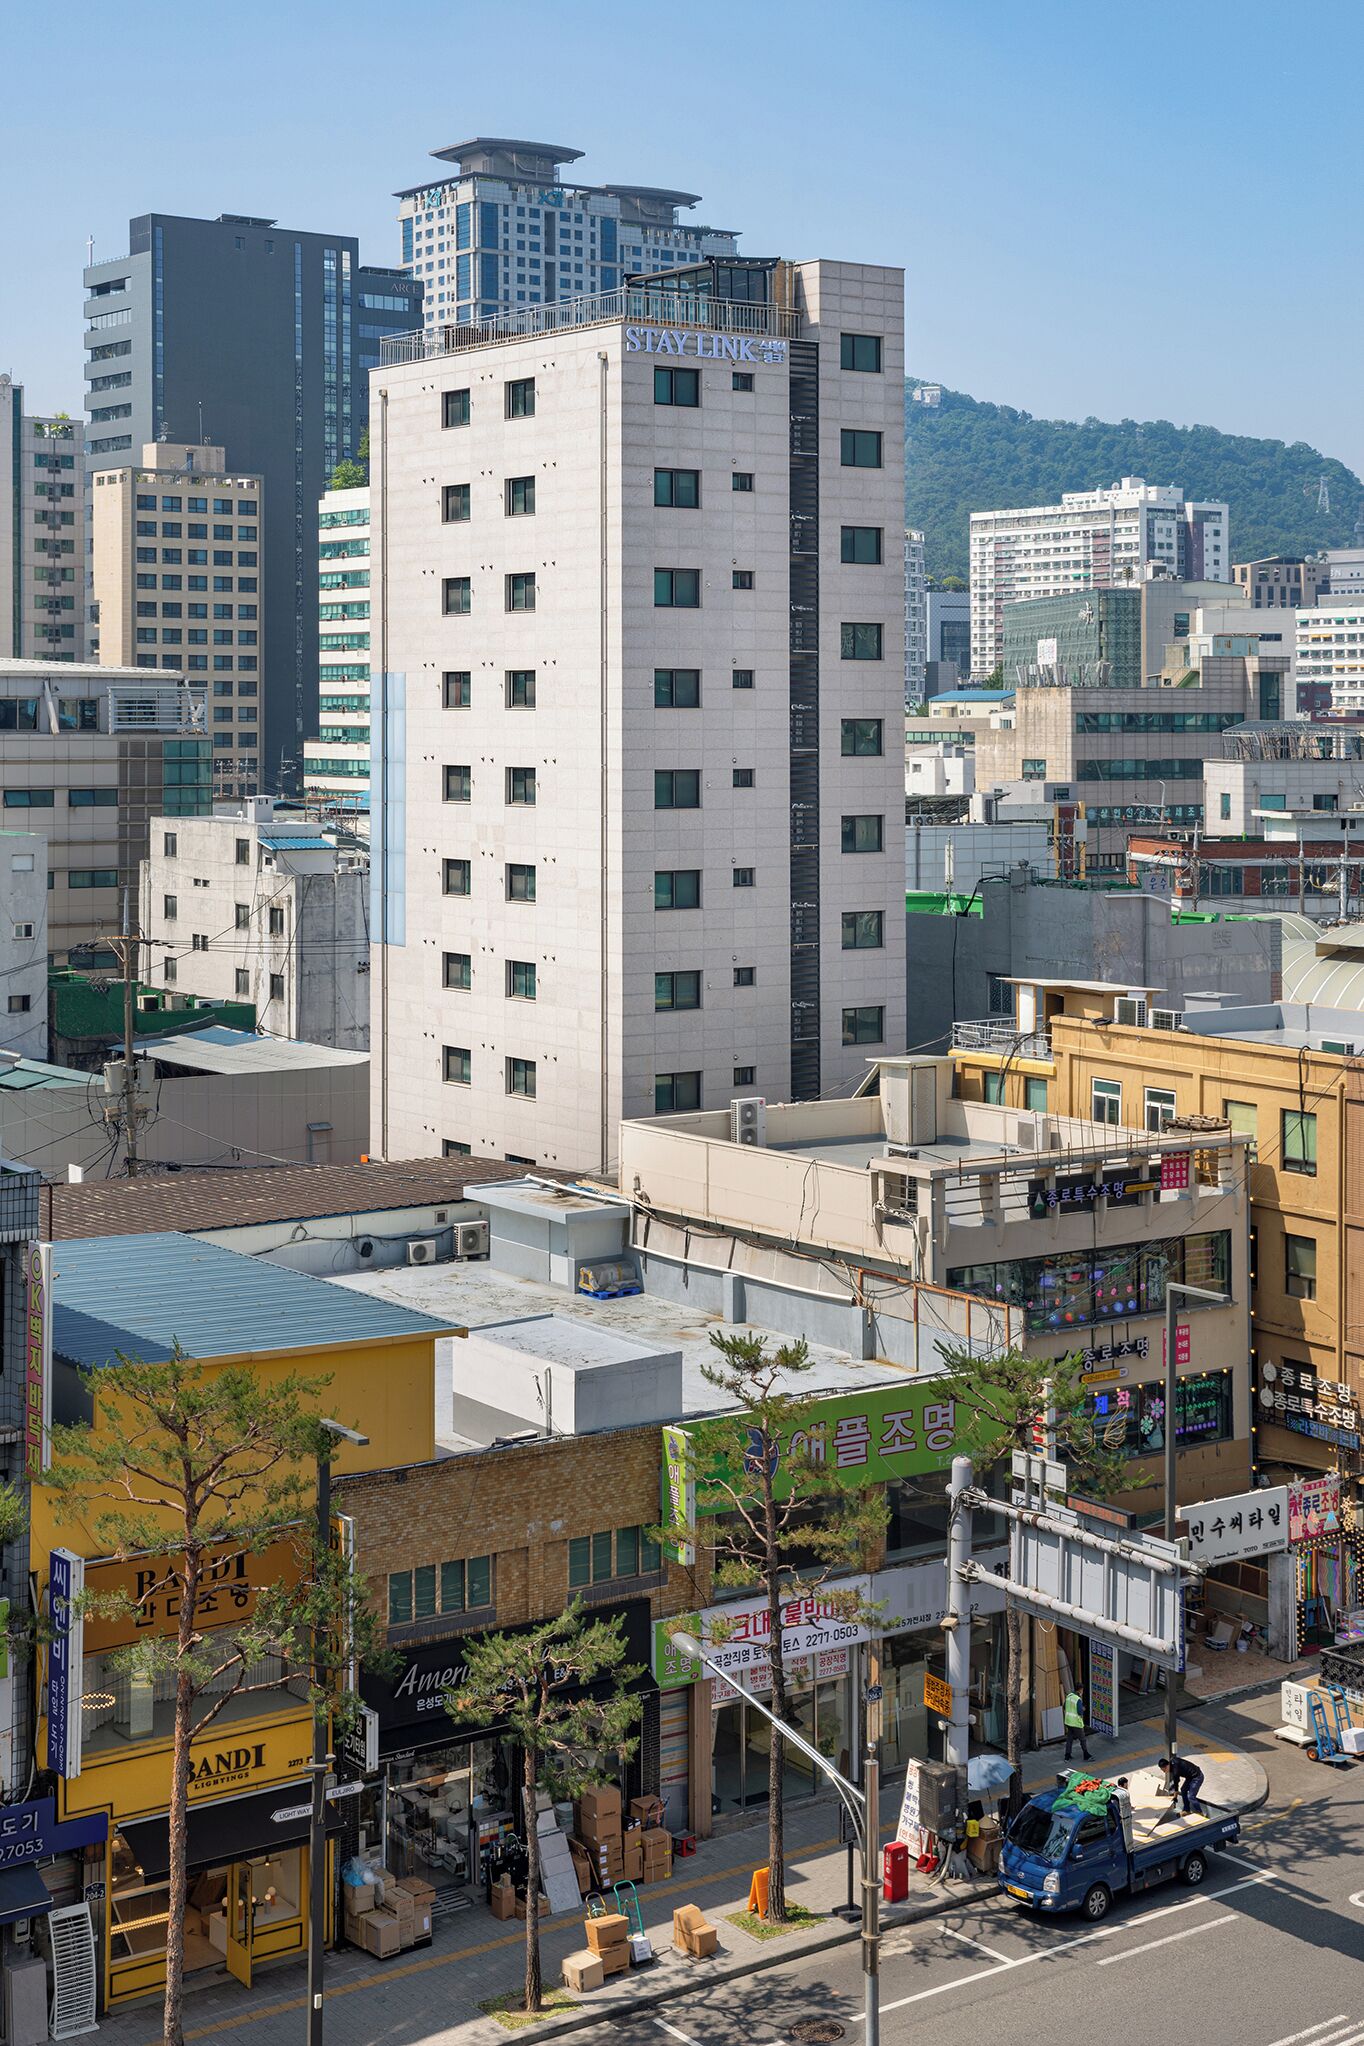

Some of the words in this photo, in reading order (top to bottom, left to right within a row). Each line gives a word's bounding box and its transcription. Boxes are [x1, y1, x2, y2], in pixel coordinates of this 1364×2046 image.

[626, 327, 691, 356] STAY
[695, 333, 759, 363] LINK
[1046, 1181, 1125, 1208] 종로특수조명
[1082, 1338, 1149, 1371] 종로조명
[1281, 1366, 1350, 1403] 종로조명
[1274, 1391, 1356, 1430] 종로특수조명
[1191, 1503, 1281, 1543] 민수씨타일
[724, 1607, 771, 1641] 크대
[394, 1664, 471, 1699] Ameri
[194, 1771, 249, 1790] LIGHTINGS
[331, 1786, 355, 1797] EULJIRO
[1, 1811, 38, 1837] 도기
[279, 1809, 297, 1820] LIGHT
[297, 1807, 310, 1817] WAY
[86, 1889, 105, 1902] 204-2
